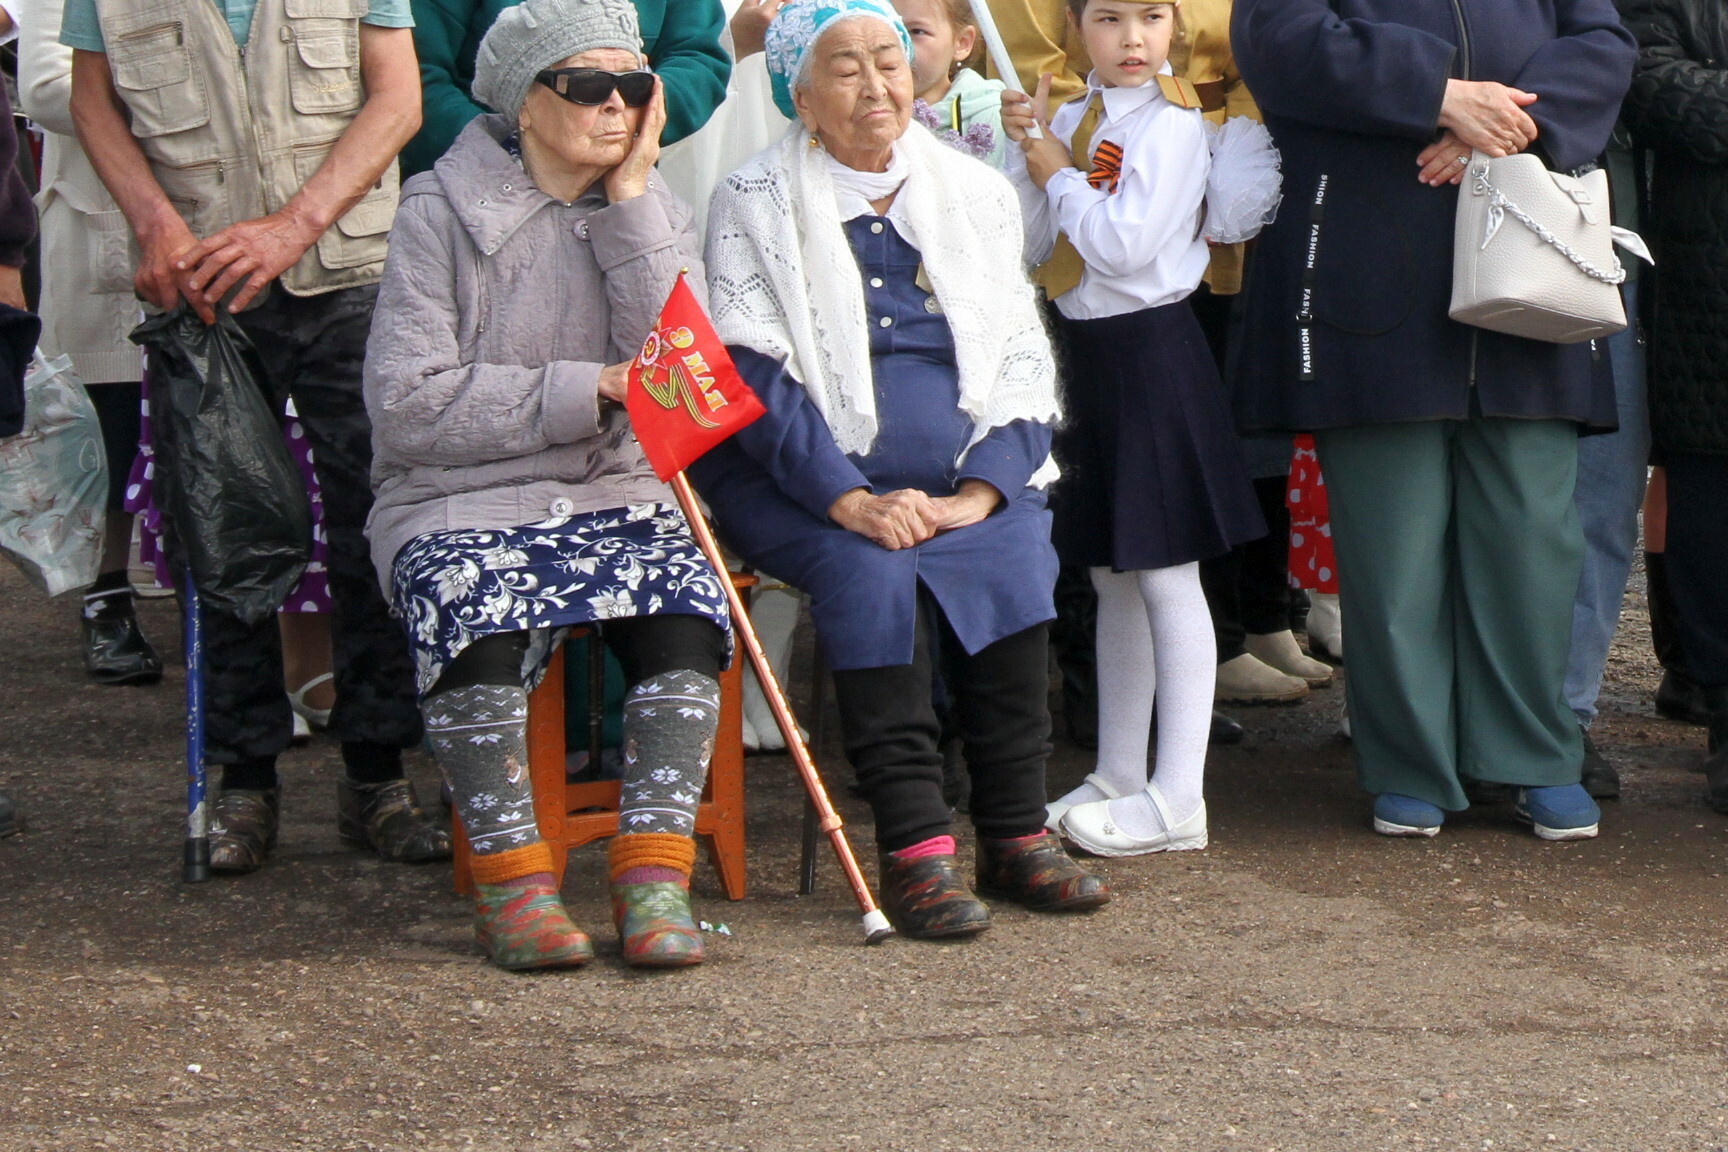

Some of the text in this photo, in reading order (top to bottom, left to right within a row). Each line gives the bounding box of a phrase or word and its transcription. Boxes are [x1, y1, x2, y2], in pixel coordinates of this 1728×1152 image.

[1307, 224, 1320, 269] FASHION
[669, 326, 729, 413] 9 МАЯ
[1301, 328, 1312, 373] FASHION
